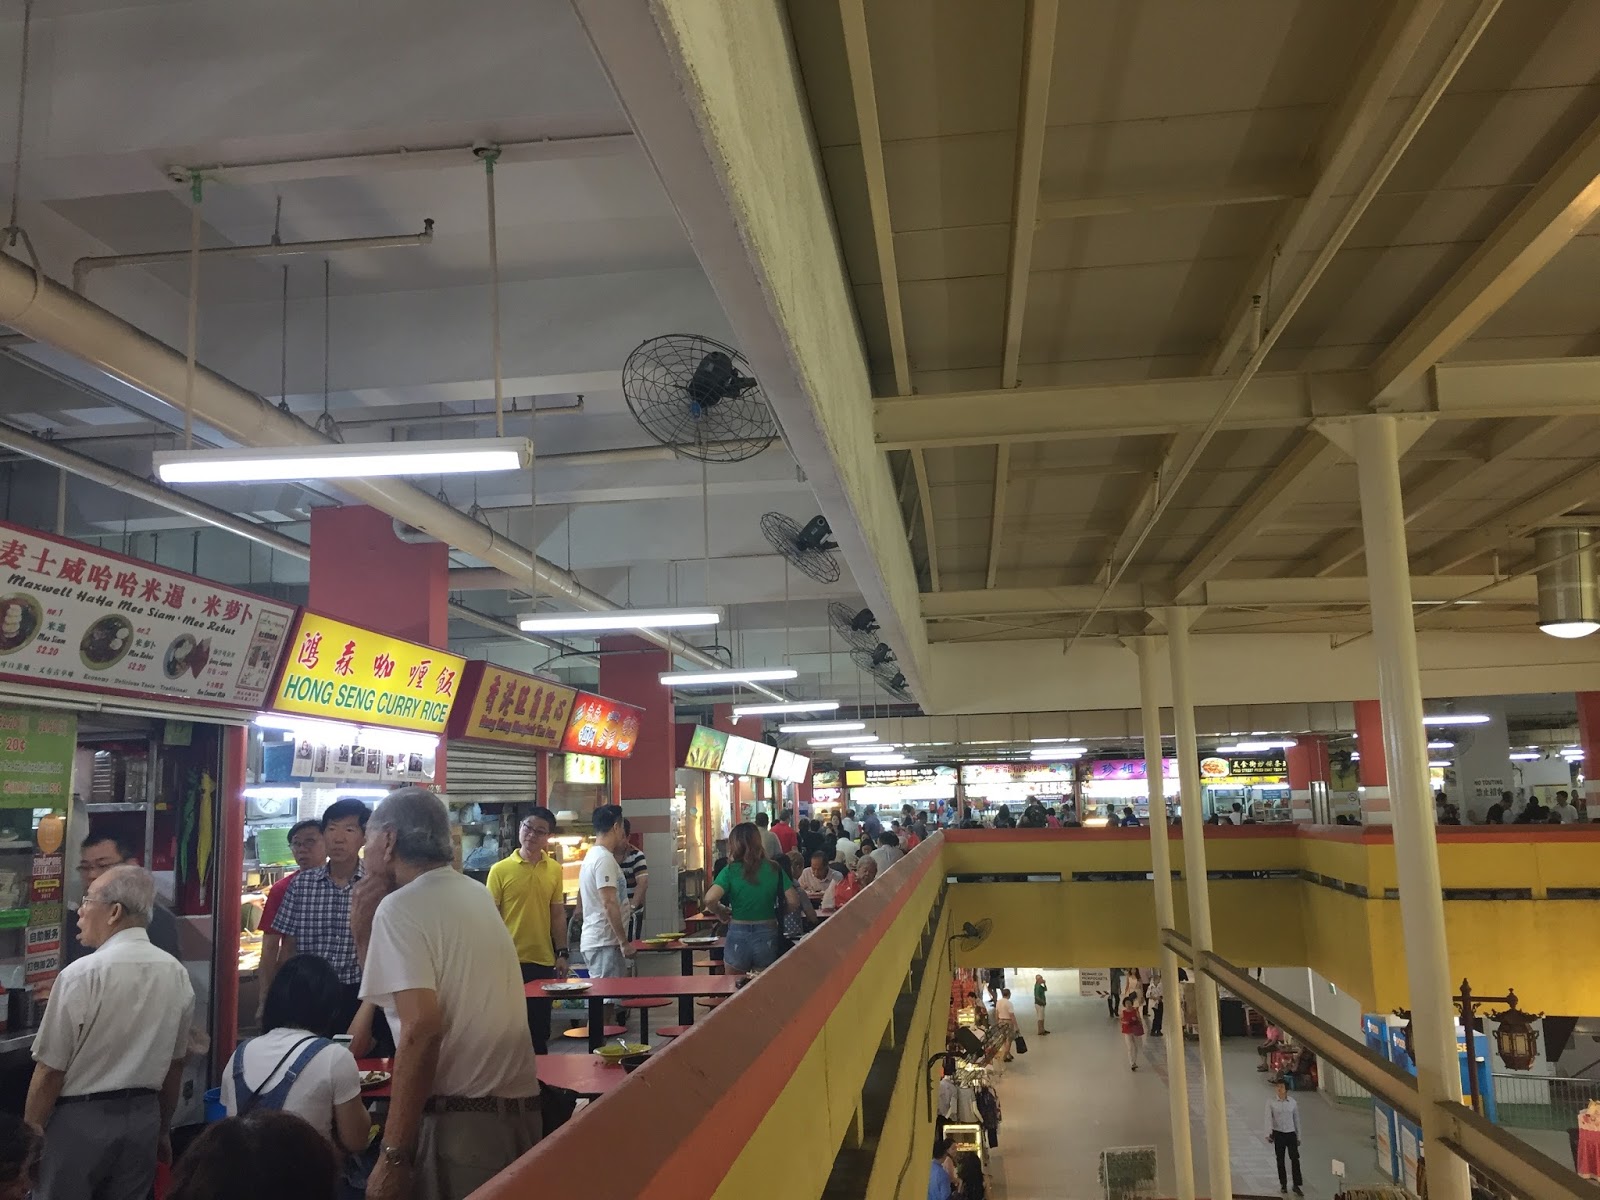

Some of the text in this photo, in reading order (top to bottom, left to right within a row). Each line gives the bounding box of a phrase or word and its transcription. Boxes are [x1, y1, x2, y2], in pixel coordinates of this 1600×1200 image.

[7, 573, 236, 637] Maxwell HaHa Mee Siam Mee Rebus
[36, 646, 60, 657] $2.20
[283, 673, 333, 706] HONG
[334, 684, 375, 712] SENG
[376, 693, 423, 721] CURRY
[423, 698, 450, 725] RICE
